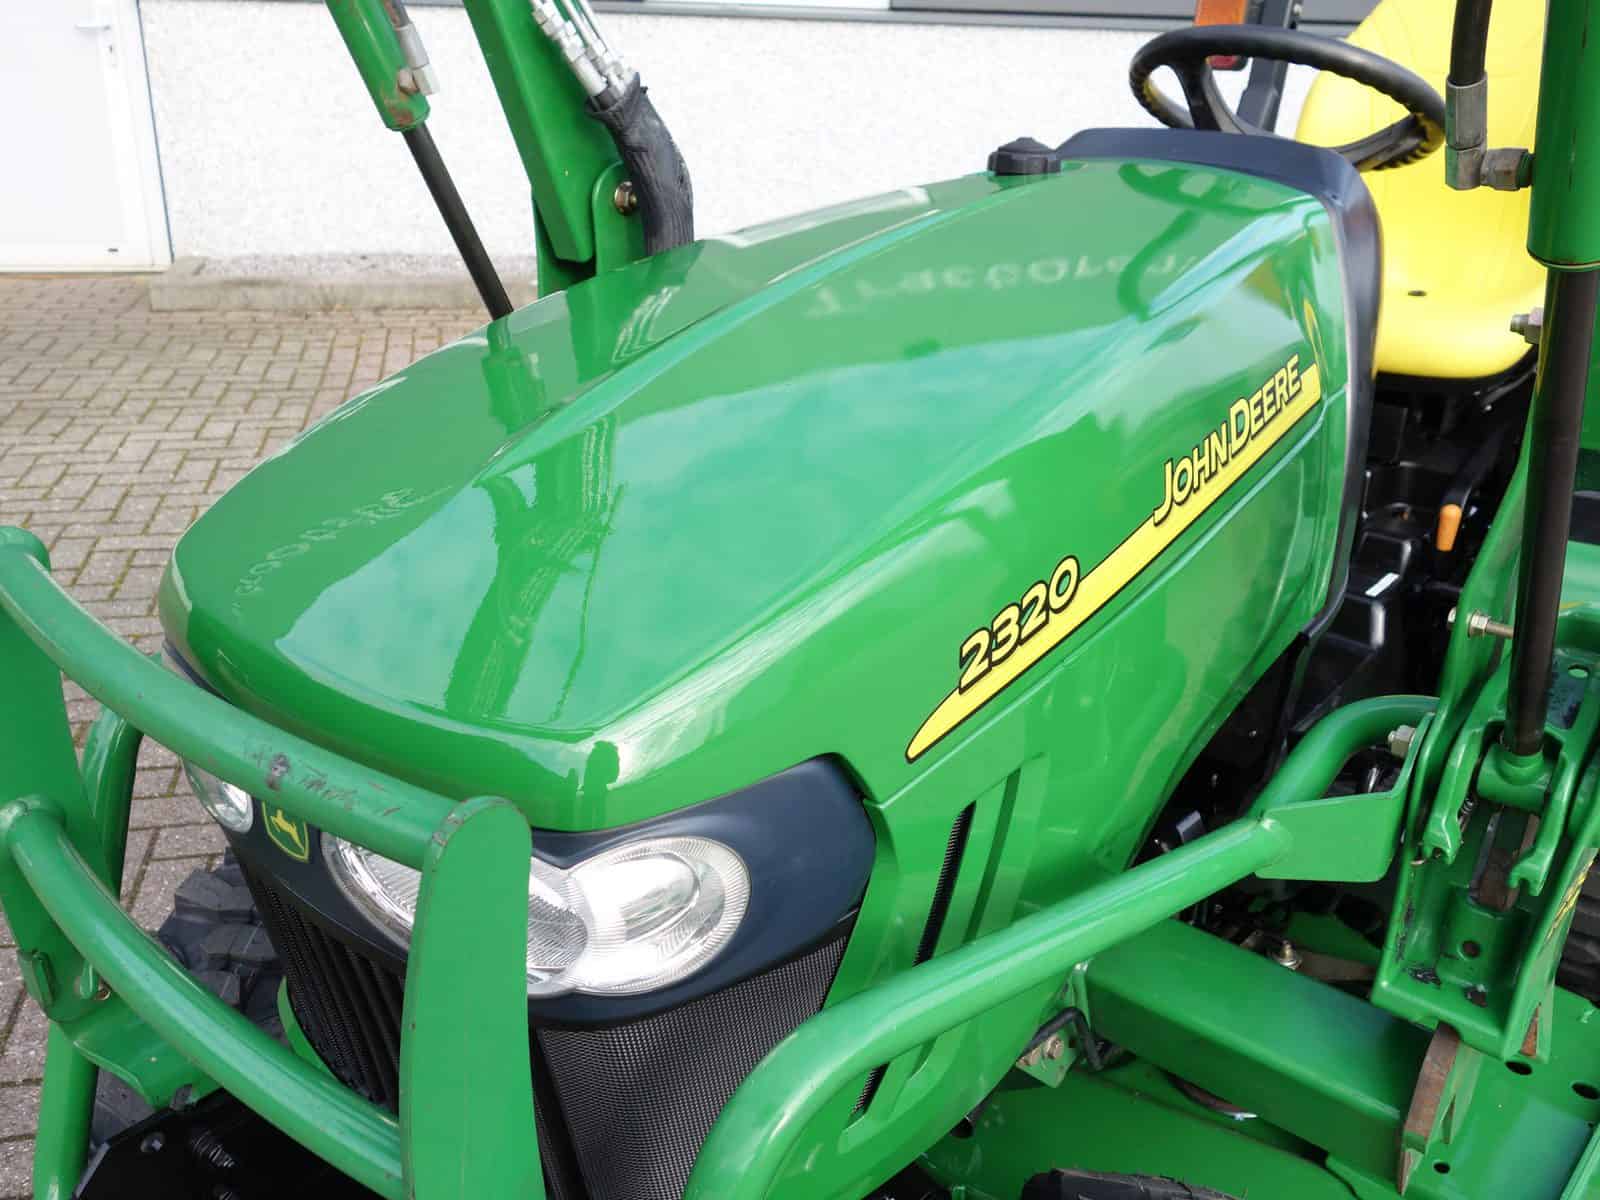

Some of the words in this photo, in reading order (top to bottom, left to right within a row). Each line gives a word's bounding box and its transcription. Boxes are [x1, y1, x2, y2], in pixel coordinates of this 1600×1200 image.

[1153, 420, 1229, 527] JOHN
[1229, 353, 1302, 458] DEERE
[959, 555, 1081, 695] 2320
